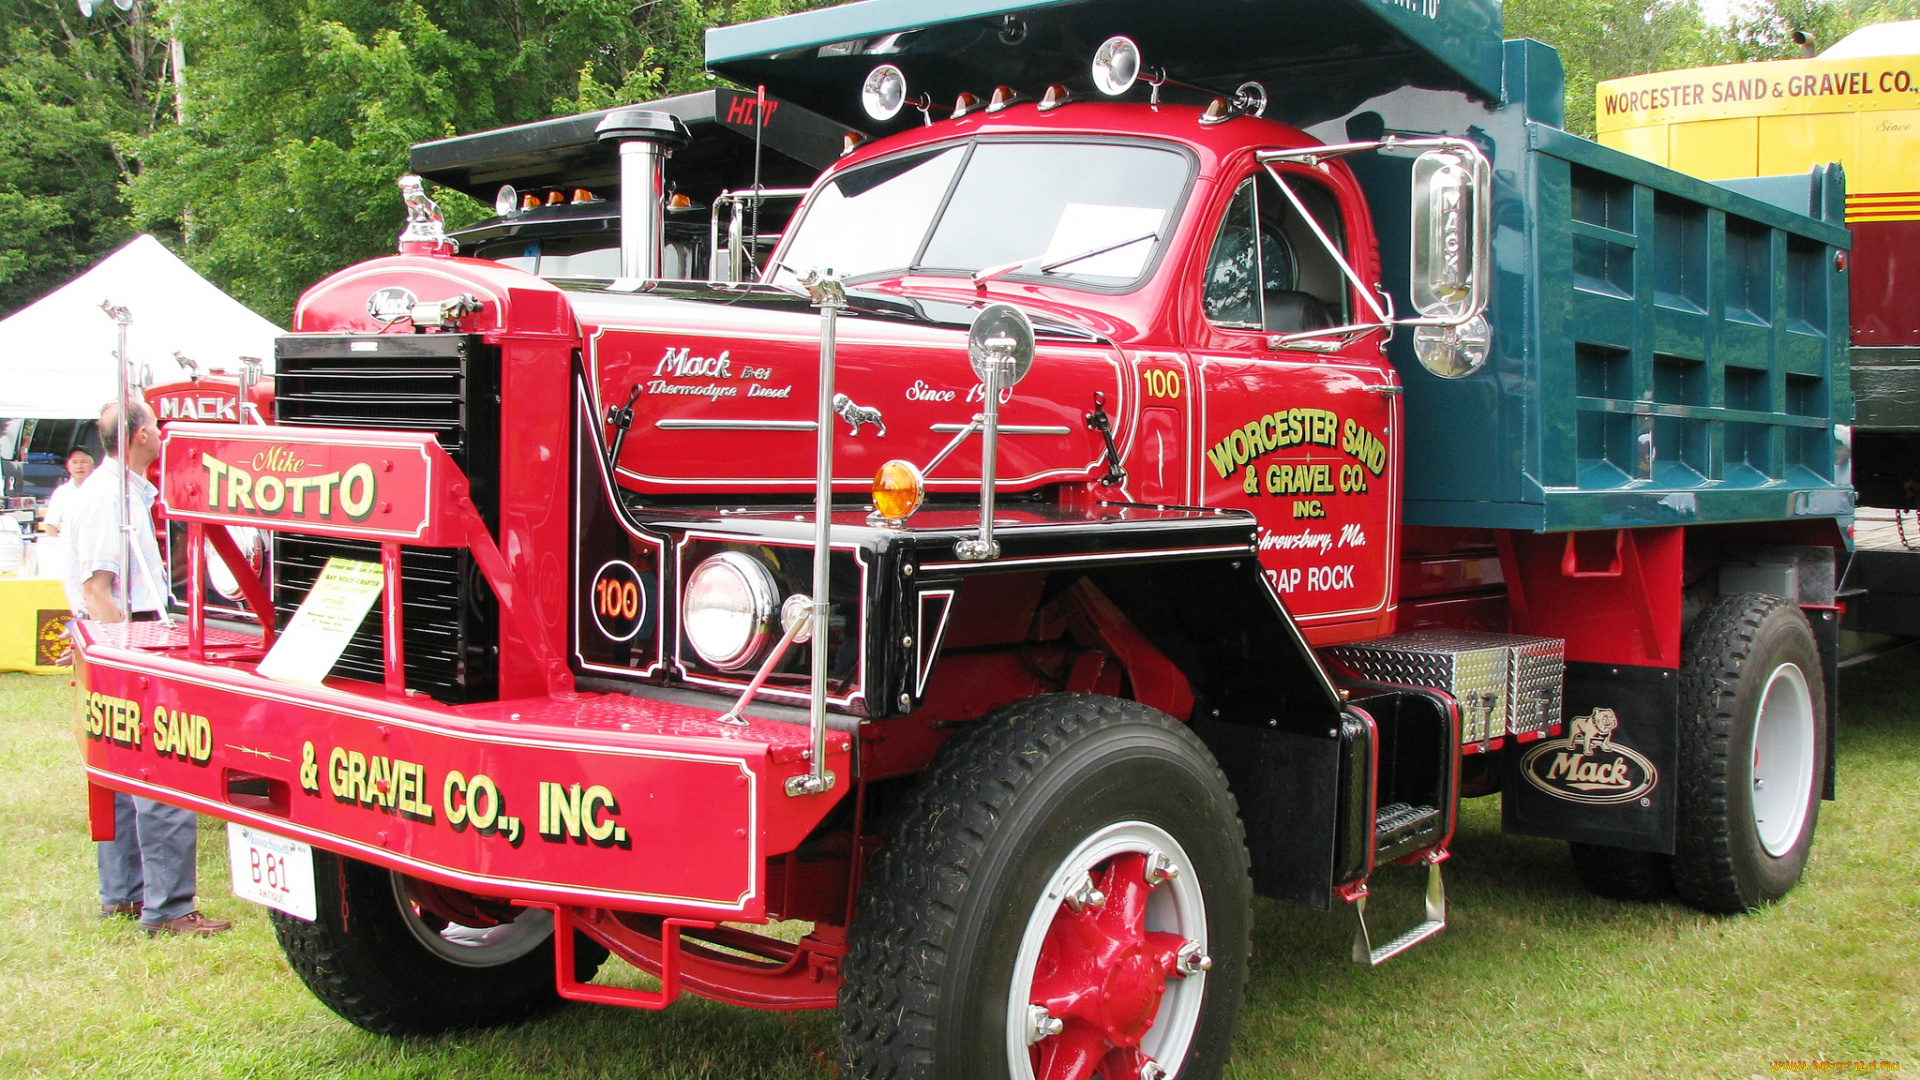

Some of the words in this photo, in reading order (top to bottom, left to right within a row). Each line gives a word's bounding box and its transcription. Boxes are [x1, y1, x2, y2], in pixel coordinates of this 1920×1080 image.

[1605, 83, 1704, 116] WORCESTER
[1711, 78, 1767, 104] SAND
[1771, 81, 1784, 98] &
[1787, 71, 1873, 97] GRAVEL
[1875, 119, 1913, 132] Since
[370, 290, 411, 316] Mack
[652, 346, 732, 379] Mack
[646, 379, 738, 402] Thermodyne
[747, 383, 793, 398] Diesel
[905, 379, 956, 402] Since
[965, 382, 1014, 405] 190
[1143, 368, 1180, 399] 100
[160, 396, 237, 420] MACK
[252, 444, 305, 473] Mike
[1206, 407, 1339, 479] WORCESTER
[1342, 418, 1387, 475] SAND
[202, 451, 376, 520] TROTTO
[1243, 464, 1258, 494] &
[1265, 464, 1335, 493] GRAVEL
[1339, 463, 1367, 492] CO.
[1292, 500, 1325, 518] INC.
[1257, 524, 1334, 556] hrewsbury,
[1337, 522, 1367, 549] Ma.
[1307, 564, 1355, 592] ROCK
[596, 577, 639, 620] 100
[153, 705, 212, 765] SAND
[300, 740, 319, 792] &
[328, 745, 433, 818] GRAVEL
[443, 771, 521, 844] CO.,
[538, 781, 628, 843] INC.
[1546, 752, 1631, 788] Mack
[250, 846, 262, 884] B
[266, 852, 290, 894] 81
